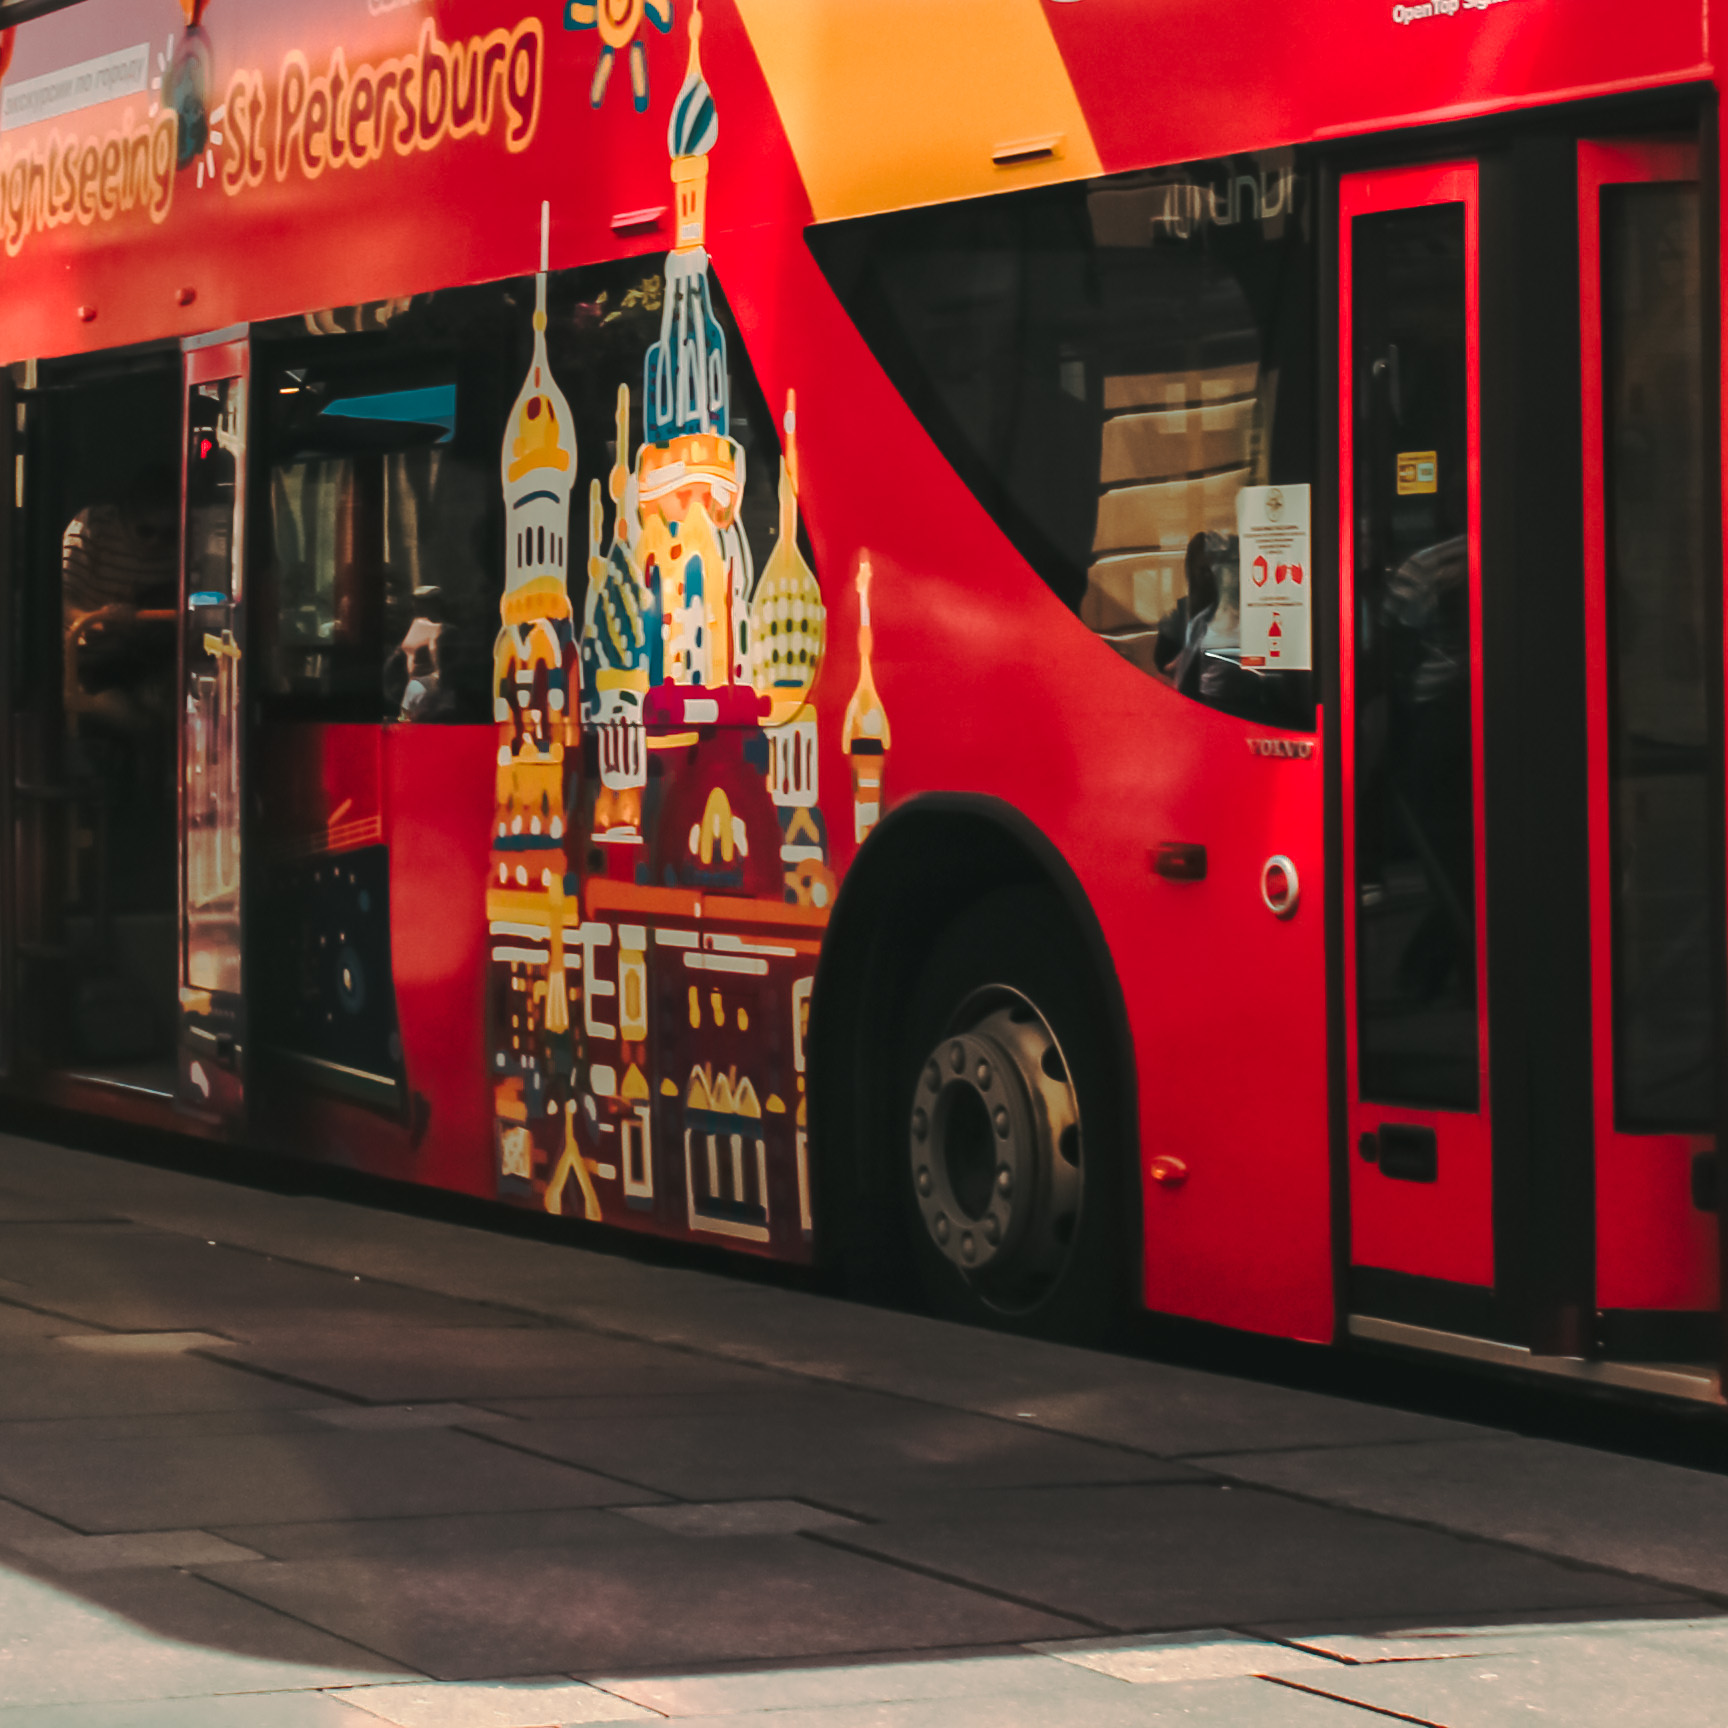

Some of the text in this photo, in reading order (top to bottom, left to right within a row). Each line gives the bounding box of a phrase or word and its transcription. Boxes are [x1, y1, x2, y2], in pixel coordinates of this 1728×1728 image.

[222, 16, 544, 197] St Petersburg
[1246, 737, 1315, 760] VOLVO
